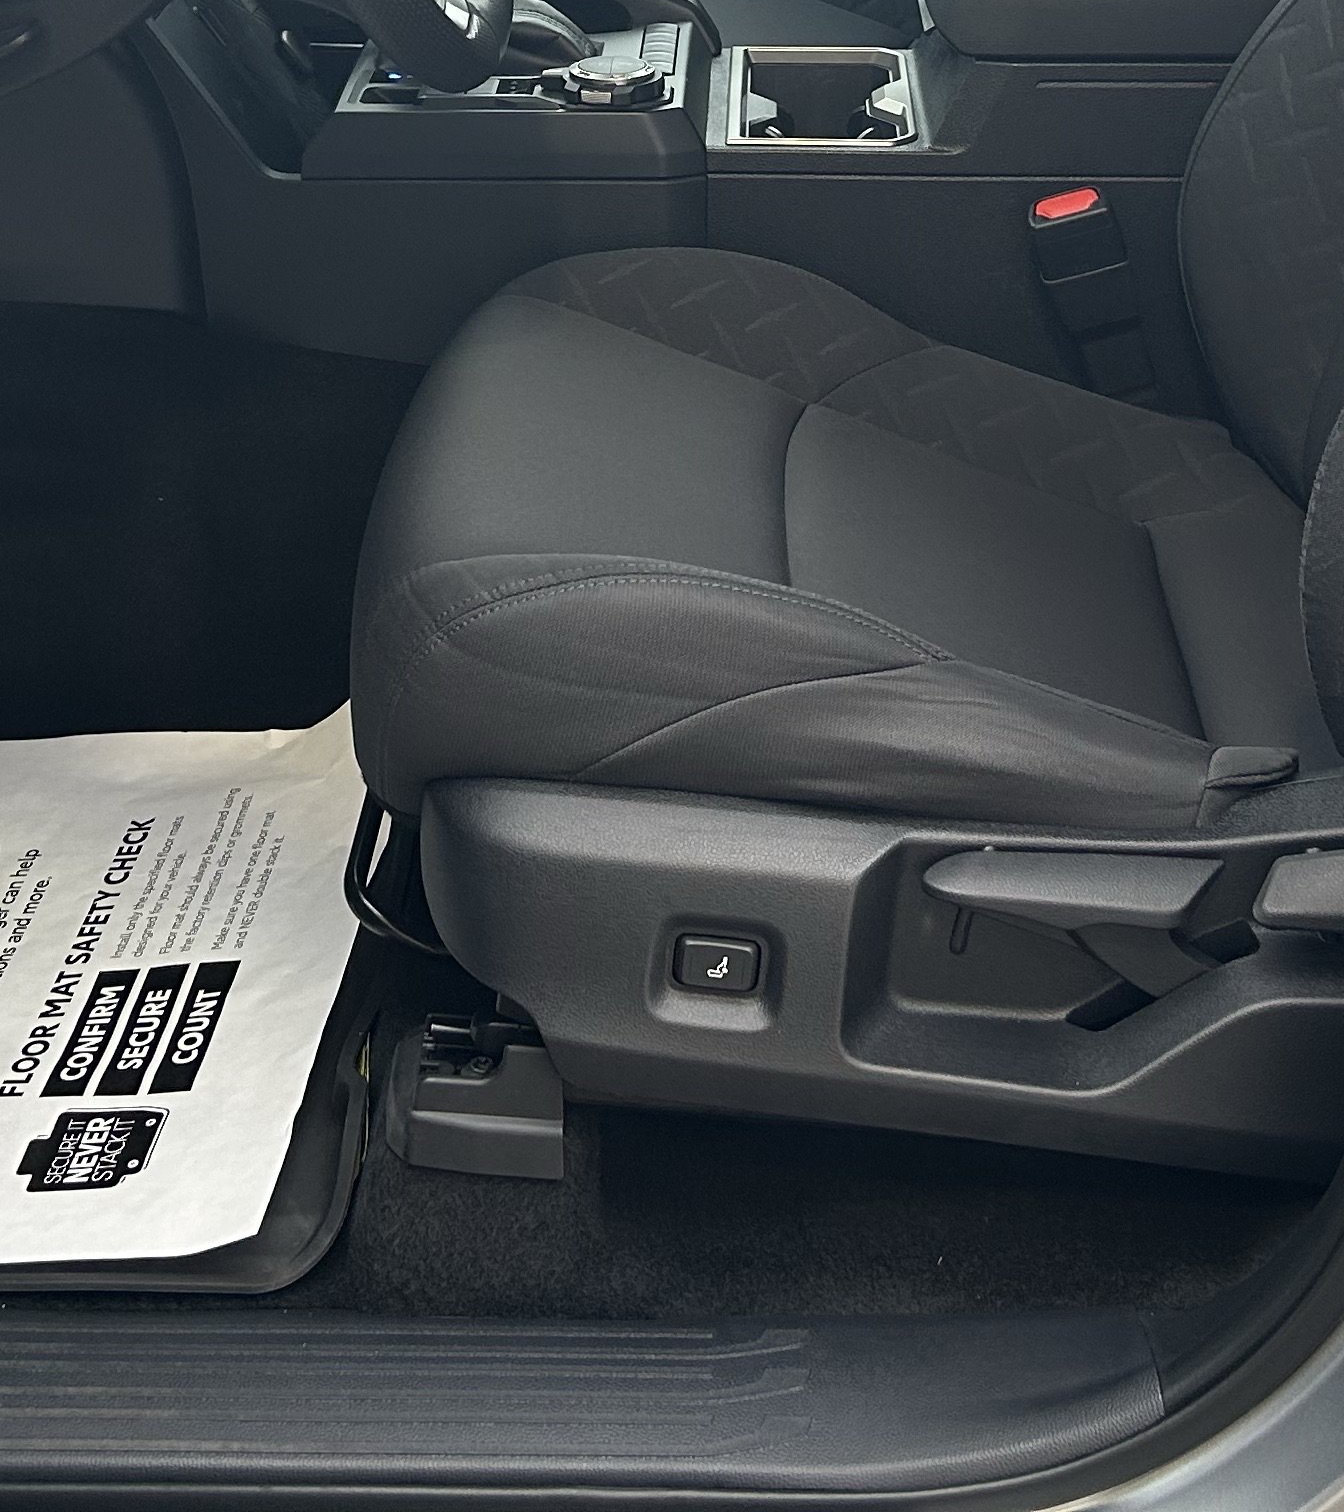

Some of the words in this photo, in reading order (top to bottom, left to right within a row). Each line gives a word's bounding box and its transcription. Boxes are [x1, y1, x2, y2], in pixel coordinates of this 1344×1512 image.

[2, 881, 24, 904] can
[10, 850, 41, 877] help
[8, 919, 31, 943] and
[38, 971, 83, 1018] MAT
[65, 890, 120, 964] SAFETY
[104, 818, 155, 884] CHECK
[60, 986, 125, 1080] CONFIRM
[117, 989, 172, 1069] SECURE
[172, 990, 221, 1064] COUNT
[44, 1133, 81, 1183] SECURE
[68, 1119, 86, 1130] IT
[63, 1117, 115, 1183] NEVER
[92, 1132, 130, 1181] STACK
[113, 1118, 135, 1131] IT
